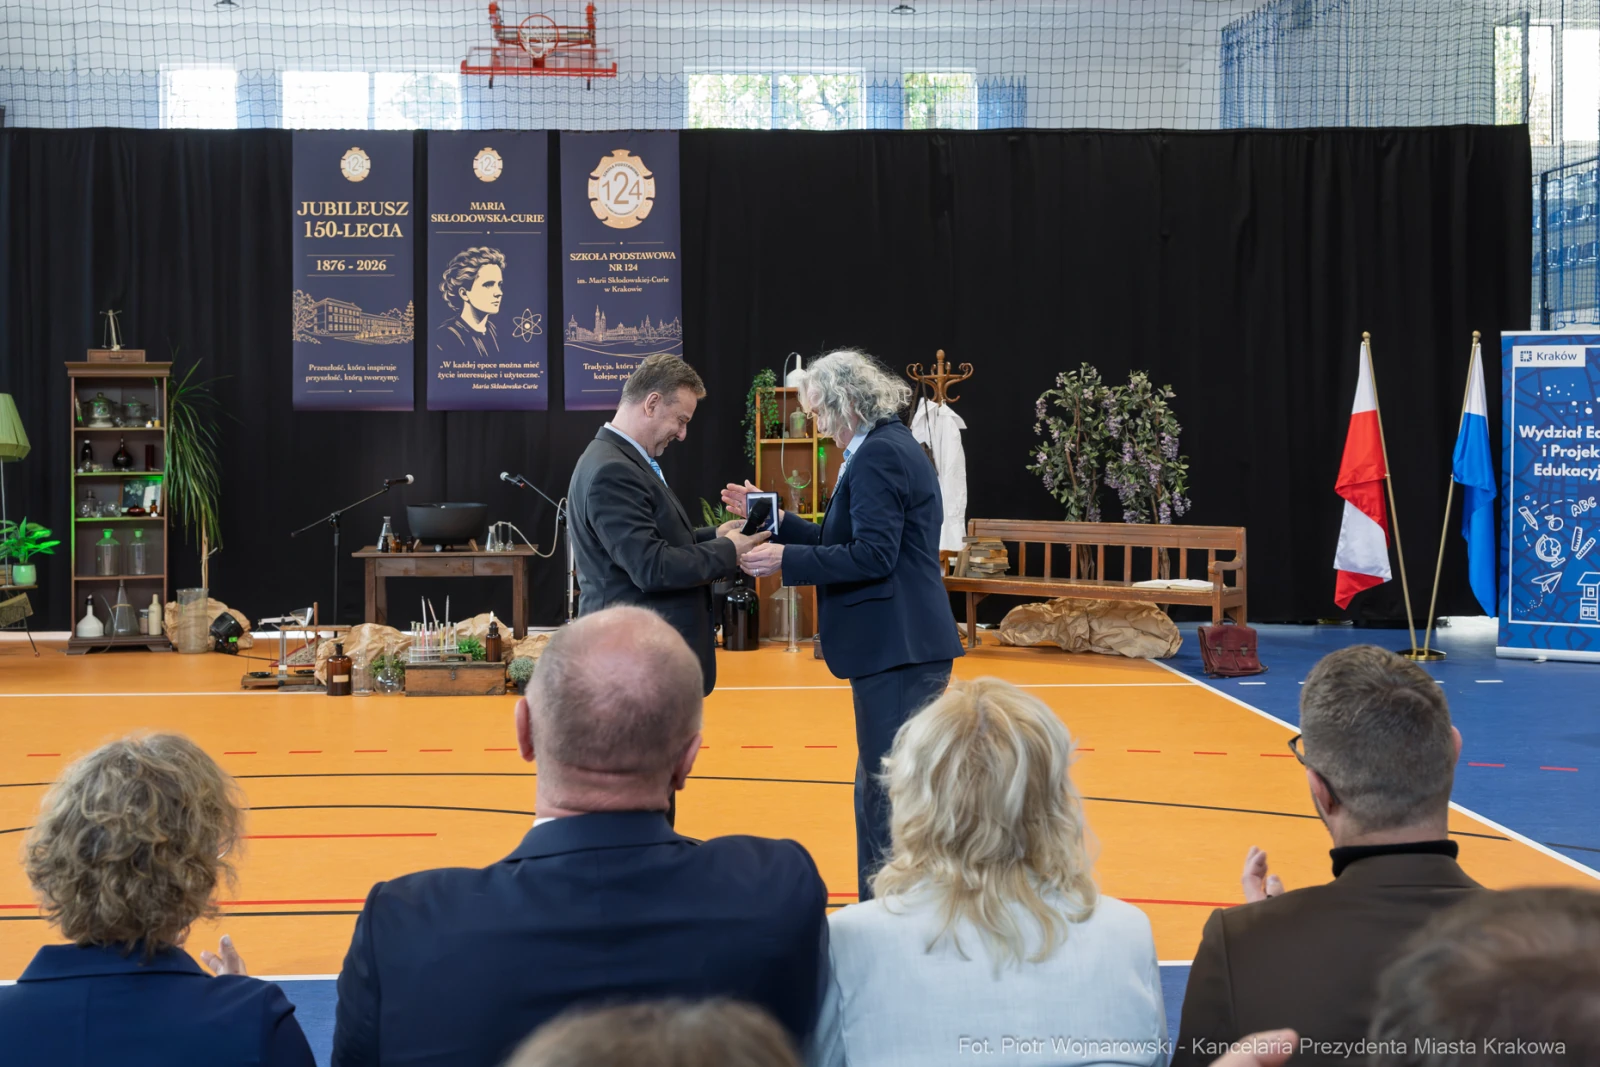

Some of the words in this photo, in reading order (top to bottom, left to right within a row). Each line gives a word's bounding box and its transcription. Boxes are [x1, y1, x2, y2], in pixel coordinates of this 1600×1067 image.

[480, 156, 497, 172] 124
[602, 171, 642, 205] 124
[296, 201, 409, 216] JUBILEUSZ
[470, 202, 506, 210] MARIA
[430, 214, 545, 223] SKŁODOWSKA-CURIE
[304, 220, 404, 238] 150-LECIA
[570, 252, 608, 261] SZKOŁA
[609, 252, 676, 260] PODSTAWOWA
[316, 260, 346, 271] 1876
[356, 260, 387, 271] 2026
[624, 263, 638, 272] 124
[1536, 350, 1578, 361] Kraków
[366, 364, 397, 372] inspiruje
[453, 360, 476, 370] każdej
[499, 361, 522, 369] można
[523, 360, 540, 369] mieć
[582, 362, 614, 372] Tradycja,
[344, 374, 363, 382] którą
[364, 374, 400, 382] tworzymy.
[437, 371, 456, 380] życie
[456, 371, 498, 380] interesujące
[593, 372, 618, 380] kolejne
[1518, 424, 1582, 442] Wydział
[1542, 444, 1547, 457] i
[1551, 444, 1600, 461] Projek
[1571, 496, 1598, 518] ABC
